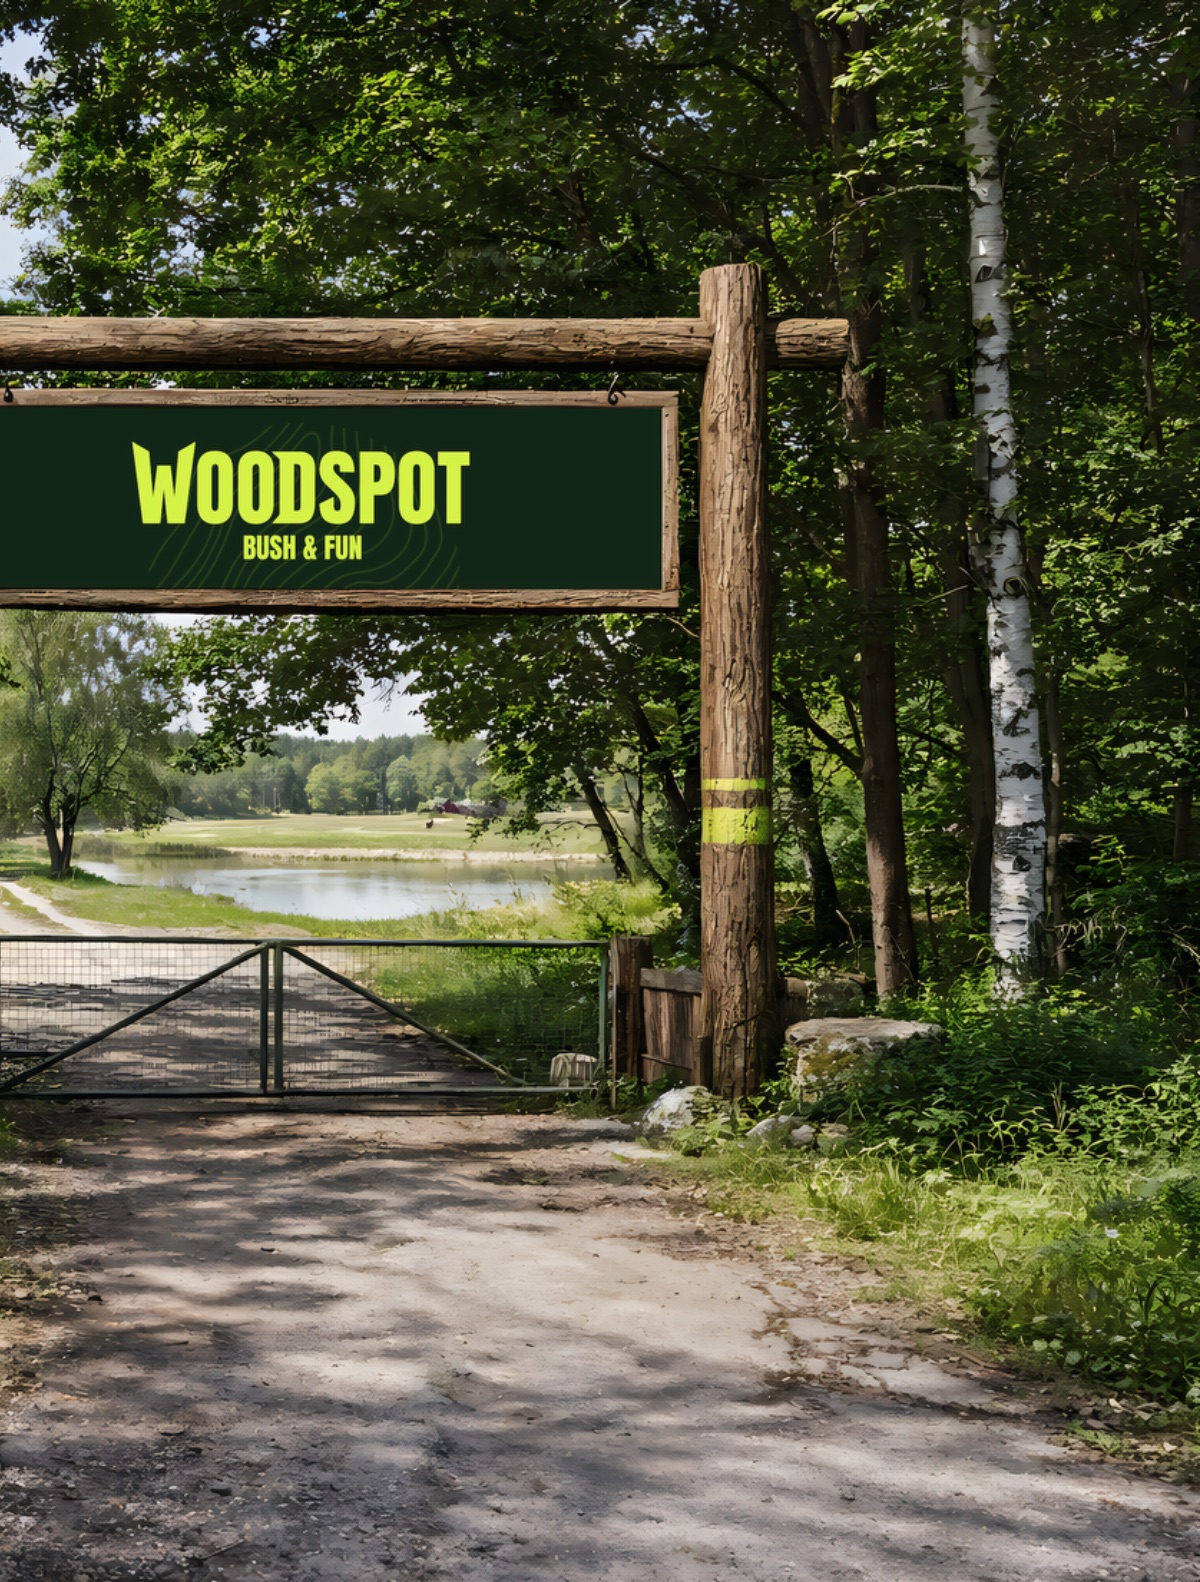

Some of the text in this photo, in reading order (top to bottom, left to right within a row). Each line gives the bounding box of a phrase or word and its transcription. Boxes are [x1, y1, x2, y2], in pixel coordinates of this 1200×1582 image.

[132, 441, 471, 525] WOODSPOT
[243, 535, 362, 560] BUSH & FUN
